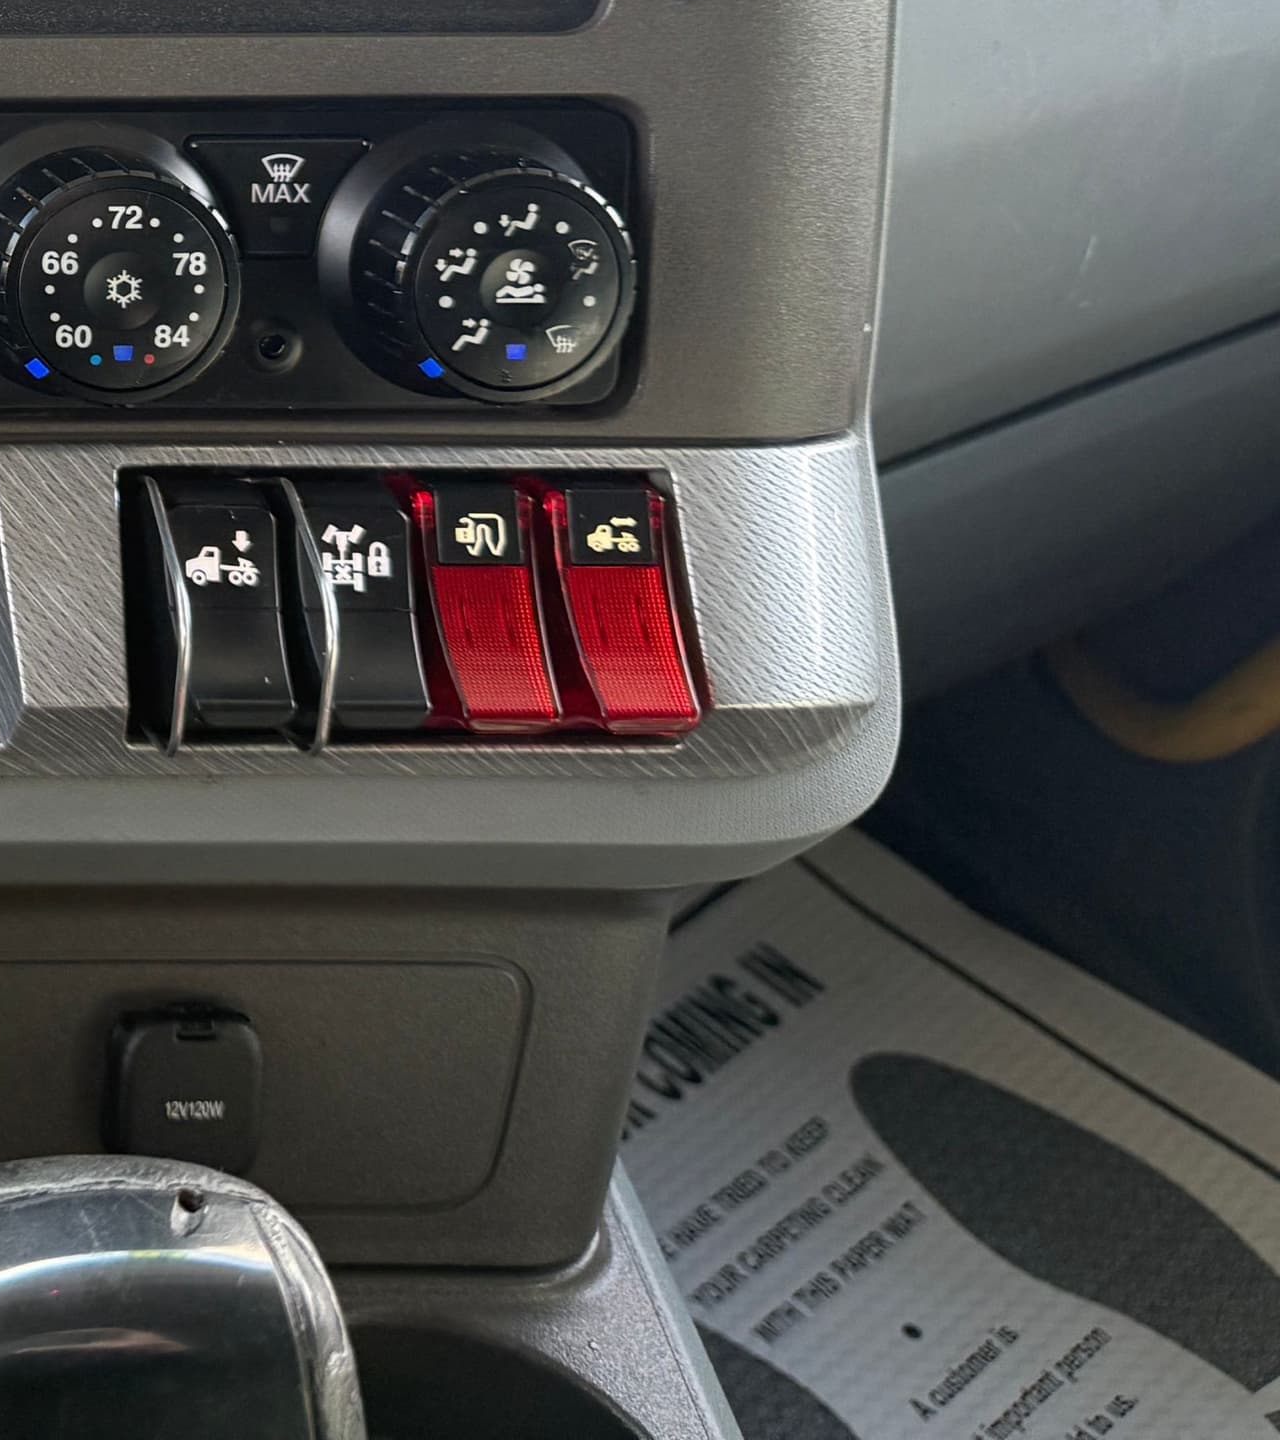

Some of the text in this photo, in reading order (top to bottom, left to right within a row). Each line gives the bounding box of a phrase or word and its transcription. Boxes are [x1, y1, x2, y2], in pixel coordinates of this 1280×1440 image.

[250, 182, 310, 204] MAX
[107, 205, 144, 231] 72
[41, 250, 79, 275] 66
[172, 252, 207, 276] 78
[55, 325, 93, 348] 60
[153, 324, 191, 348] 84
[738, 940, 826, 1009] IN
[672, 1202, 725, 1249] HAVE
[710, 1167, 769, 1211] TRIED
[758, 1149, 790, 1177] TO
[785, 1115, 829, 1158] KEEP
[690, 1151, 887, 1309] YOUR CARPETING CLEAN
[752, 1300, 804, 1343] WITH
[792, 1271, 841, 1309] THIS
[829, 1229, 893, 1281] PAPER
[907, 1325, 1019, 1423] A customer is
[1054, 1327, 1113, 1384] person
